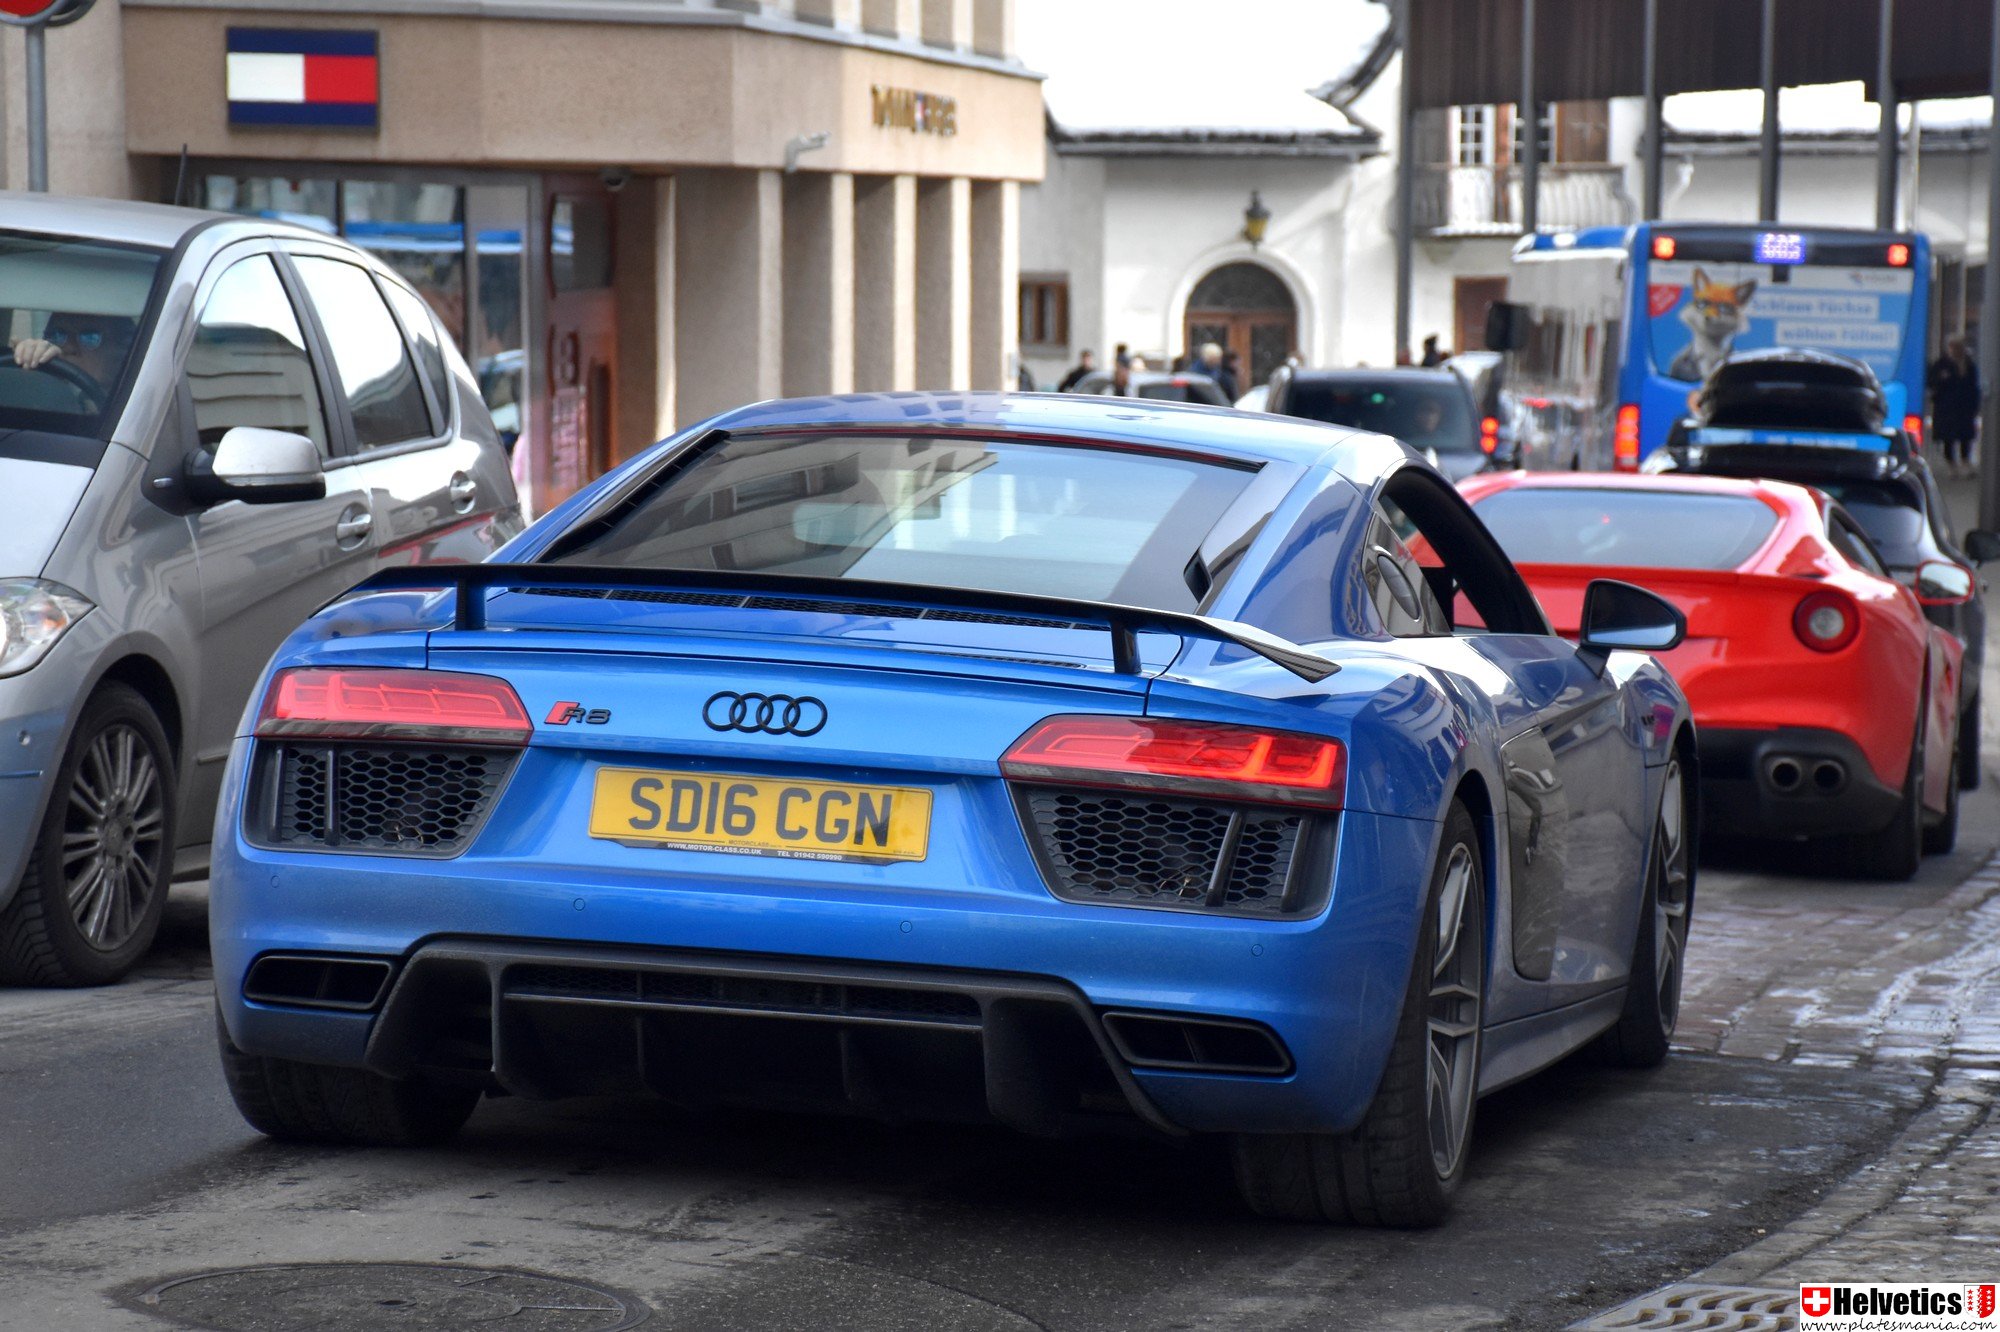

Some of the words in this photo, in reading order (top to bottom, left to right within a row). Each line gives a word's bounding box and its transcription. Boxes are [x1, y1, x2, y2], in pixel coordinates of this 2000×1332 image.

[559, 706, 612, 725] R8
[628, 777, 759, 837] SD16
[775, 787, 893, 847] CGN
[667, 842, 763, 856] WWW.MOTOR-CLASS.CO.UK
[794, 851, 815, 859] 01942
